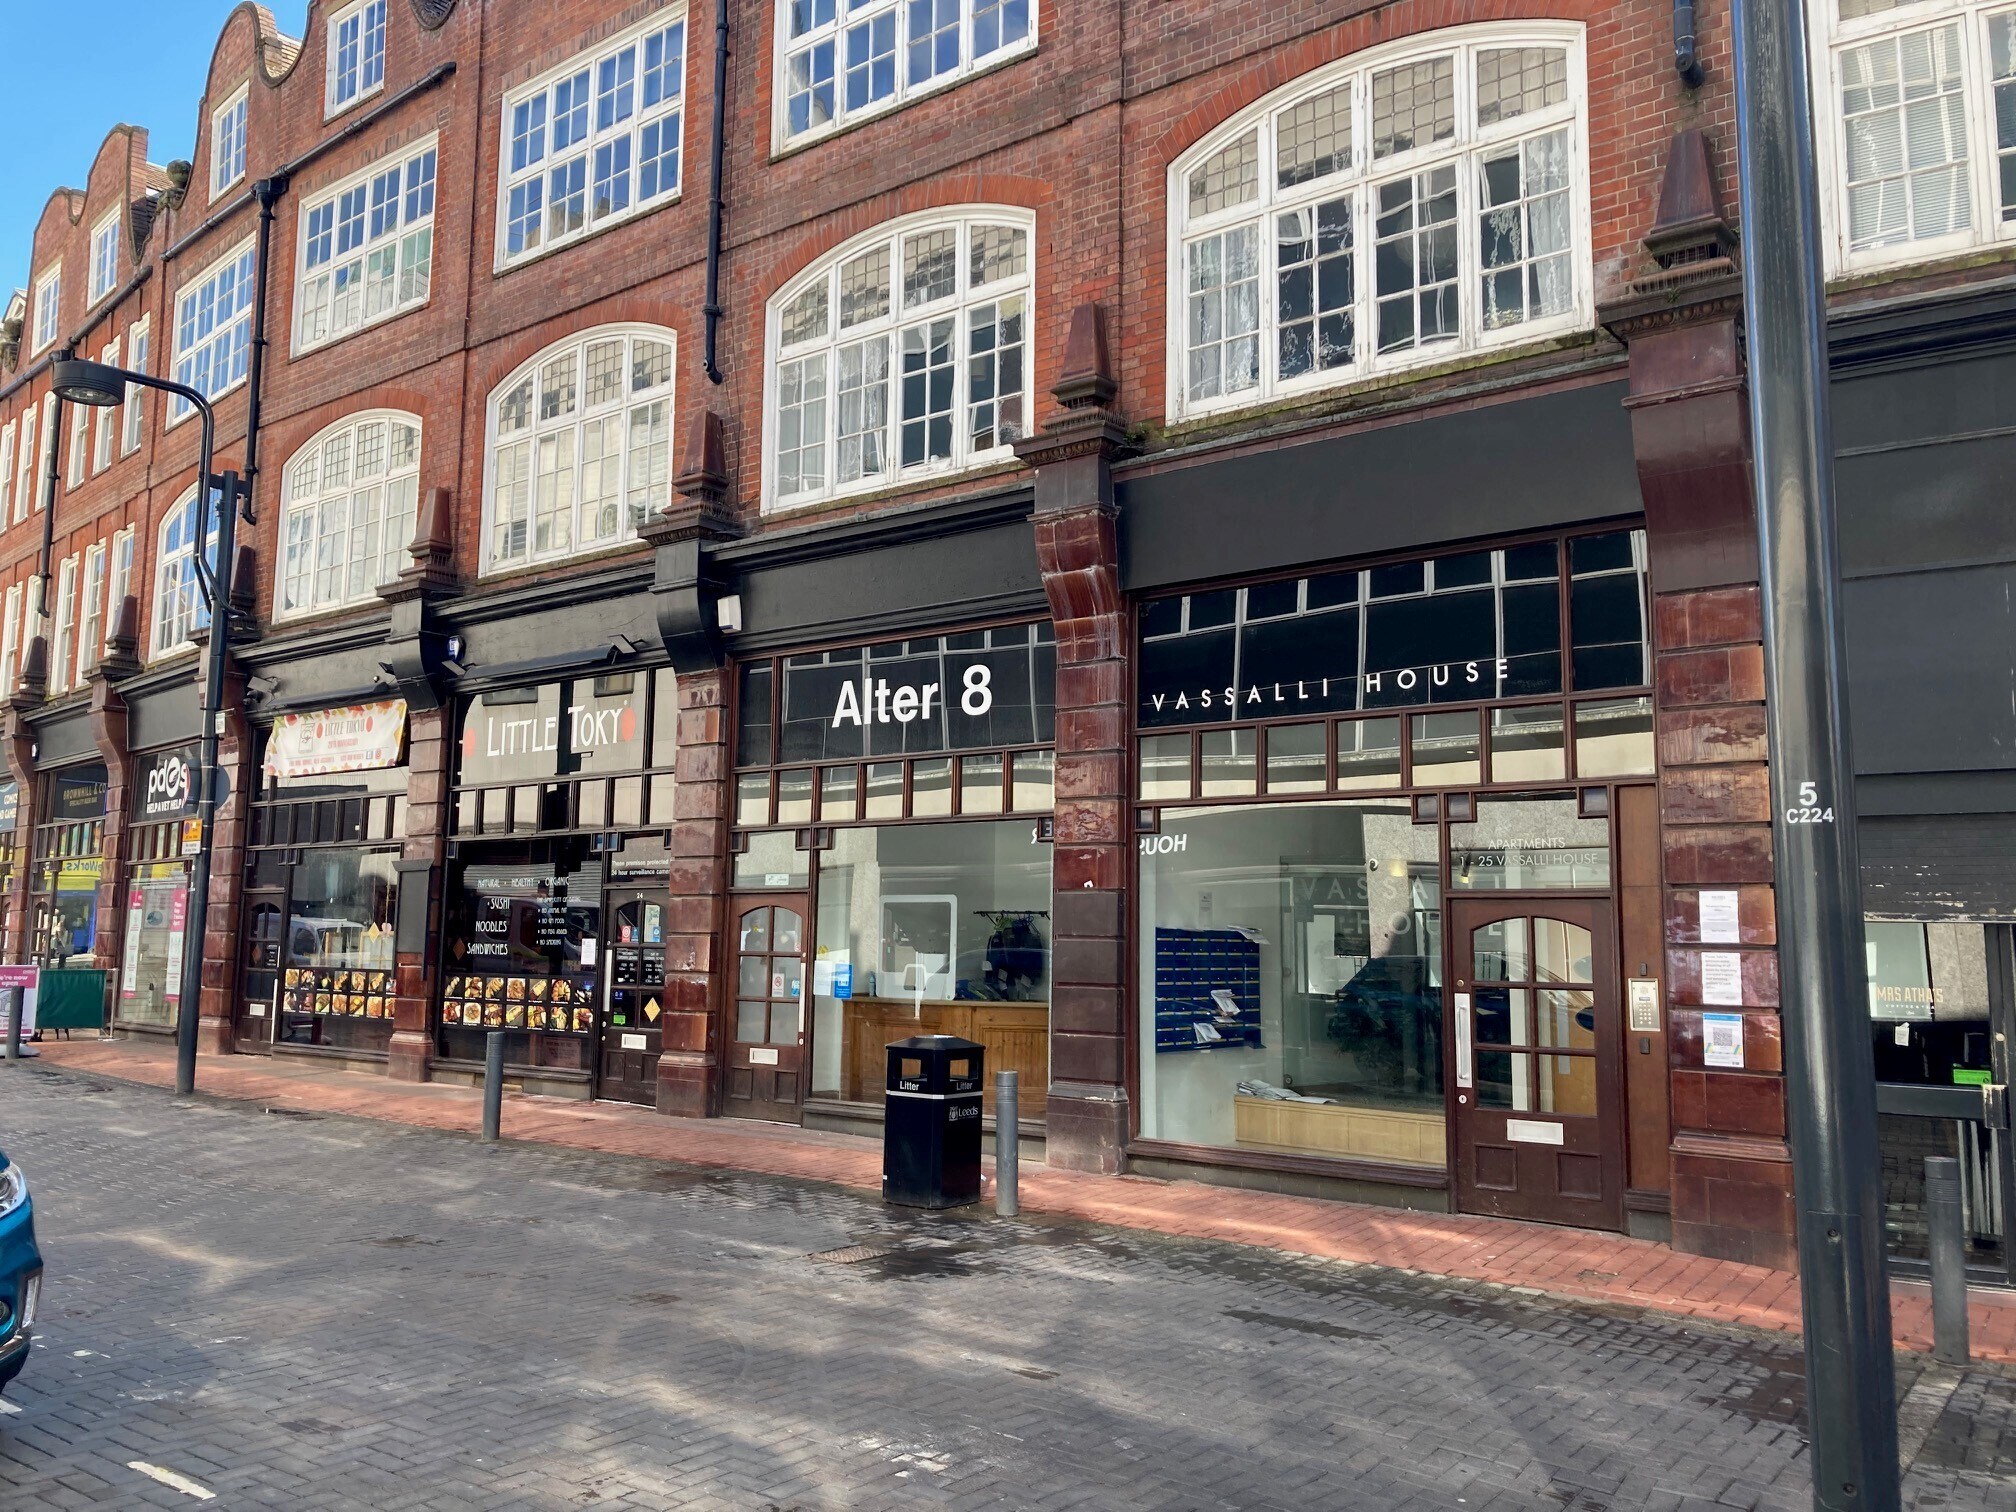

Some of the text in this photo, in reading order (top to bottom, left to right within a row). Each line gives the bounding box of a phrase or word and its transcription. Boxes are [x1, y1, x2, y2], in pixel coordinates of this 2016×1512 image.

[1152, 659, 1508, 712] VASSALLI HOUSE
[831, 664, 993, 729] Alter 8
[486, 716, 558, 757] LITTLE
[1799, 781, 1818, 806] 5
[146, 802, 158, 814] HELP
[1786, 807, 1835, 824] C224
[1488, 837, 1566, 850] APARTMENTS
[1478, 855, 1493, 867] 25
[1496, 854, 1549, 866] VASSALLI
[1553, 853, 1599, 865] HOUSE
[490, 897, 511, 910] SUSHI
[475, 920, 508, 933] NOODLES
[466, 942, 509, 956] SANDWICHES
[1876, 985, 1902, 1002] MRS
[899, 1080, 920, 1091] Litter
[956, 1081, 974, 1091] Litter
[958, 1105, 979, 1117] Leeds
